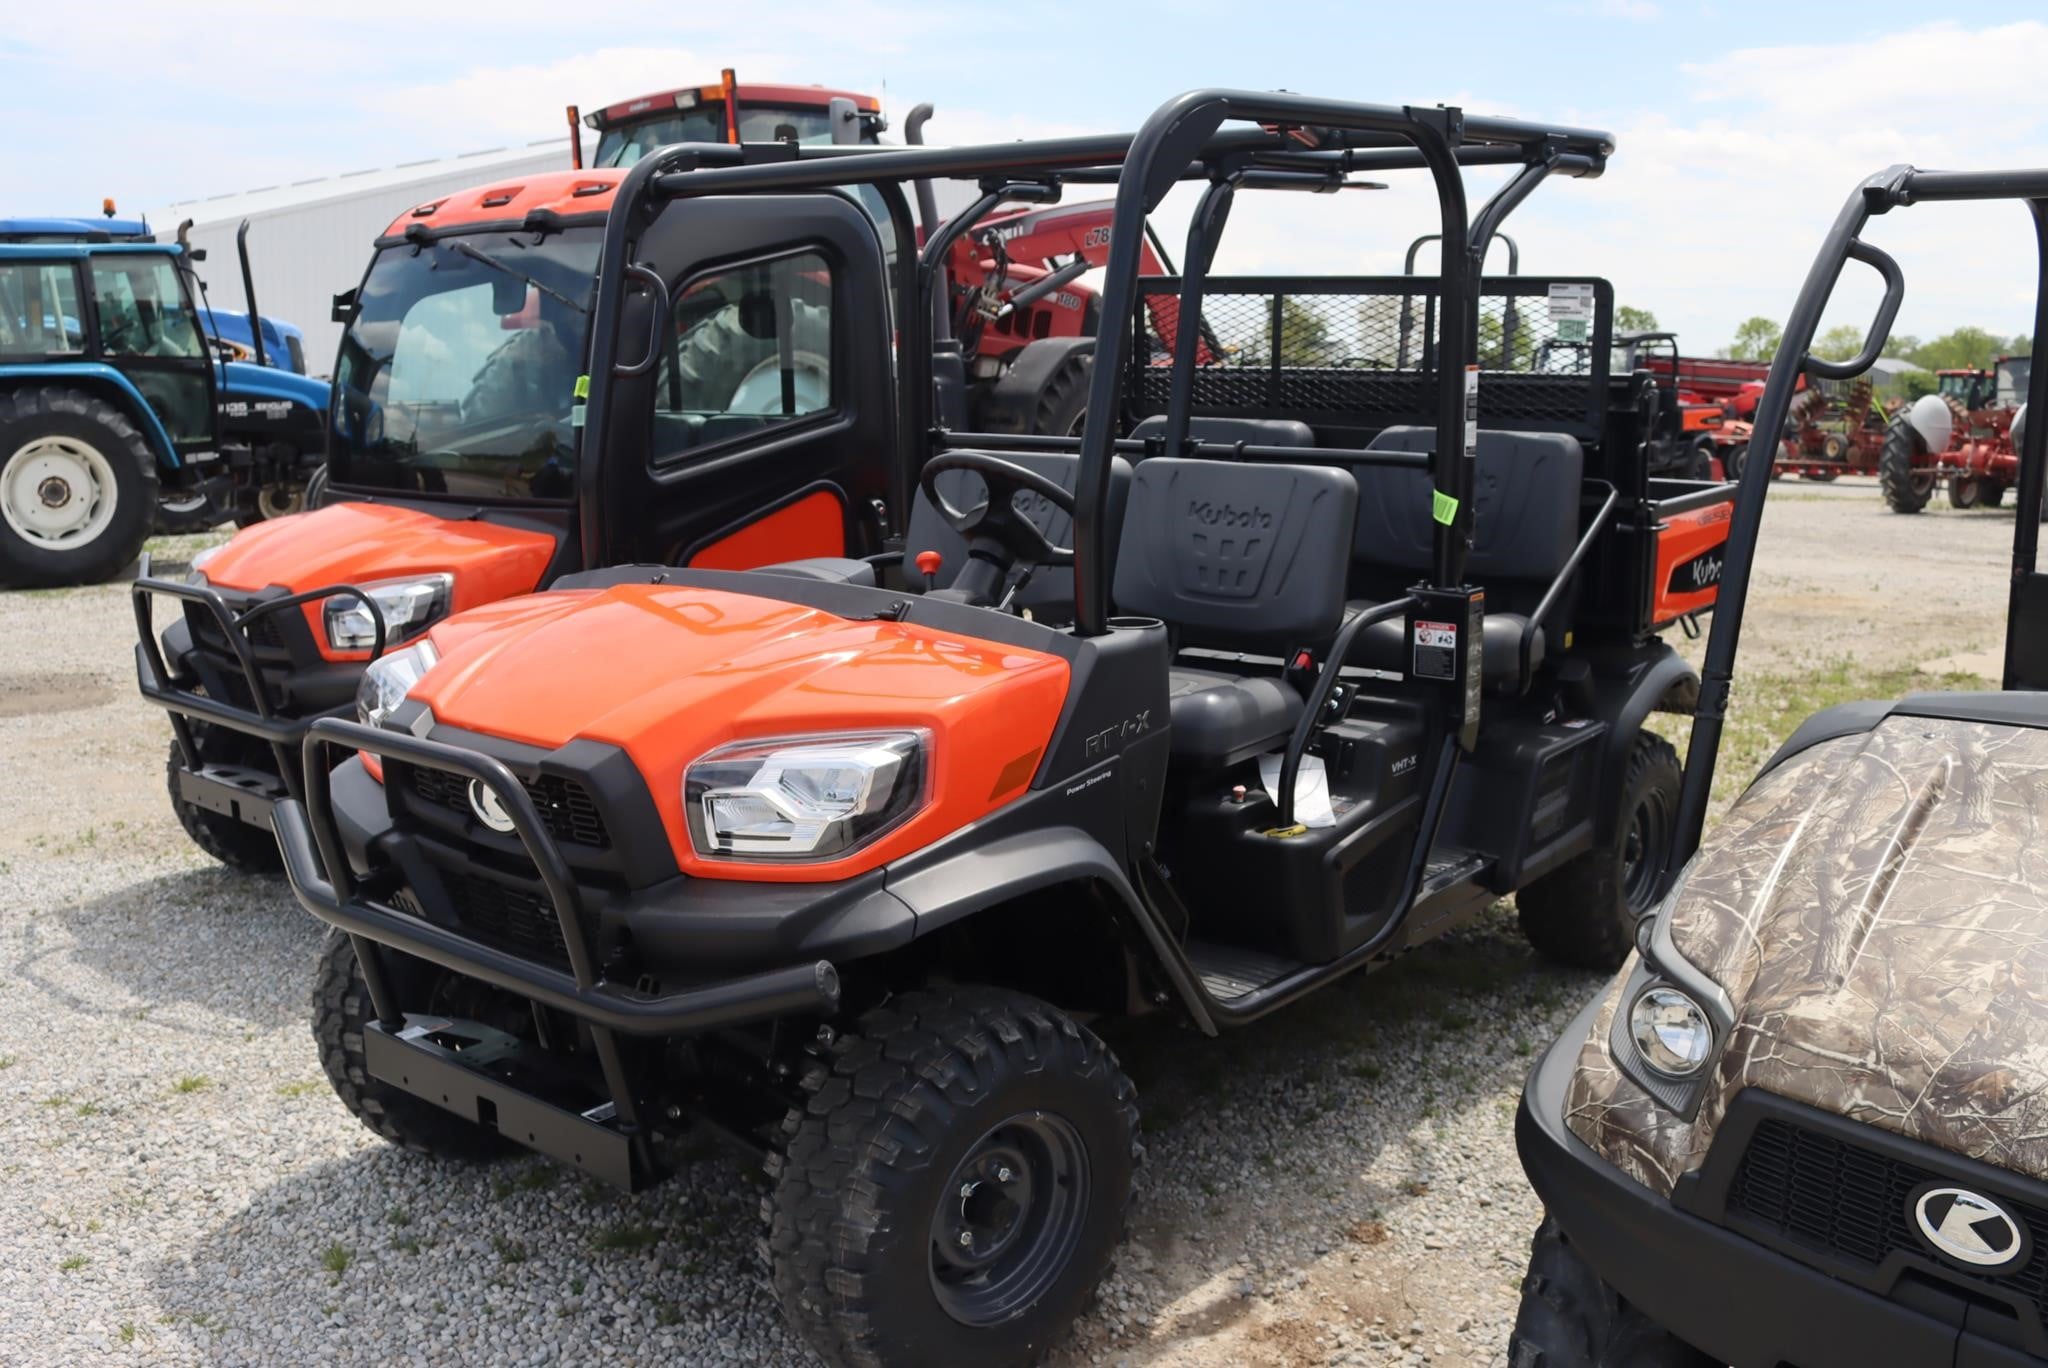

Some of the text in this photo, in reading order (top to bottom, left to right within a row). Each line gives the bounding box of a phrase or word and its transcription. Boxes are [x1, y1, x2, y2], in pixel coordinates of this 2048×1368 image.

[1084, 227, 1112, 248] L78
[1058, 291, 1081, 310] 180
[1188, 500, 1272, 529] Kubota
[1693, 557, 1722, 586] Kubo
[1066, 770, 1112, 796] Power Steering
